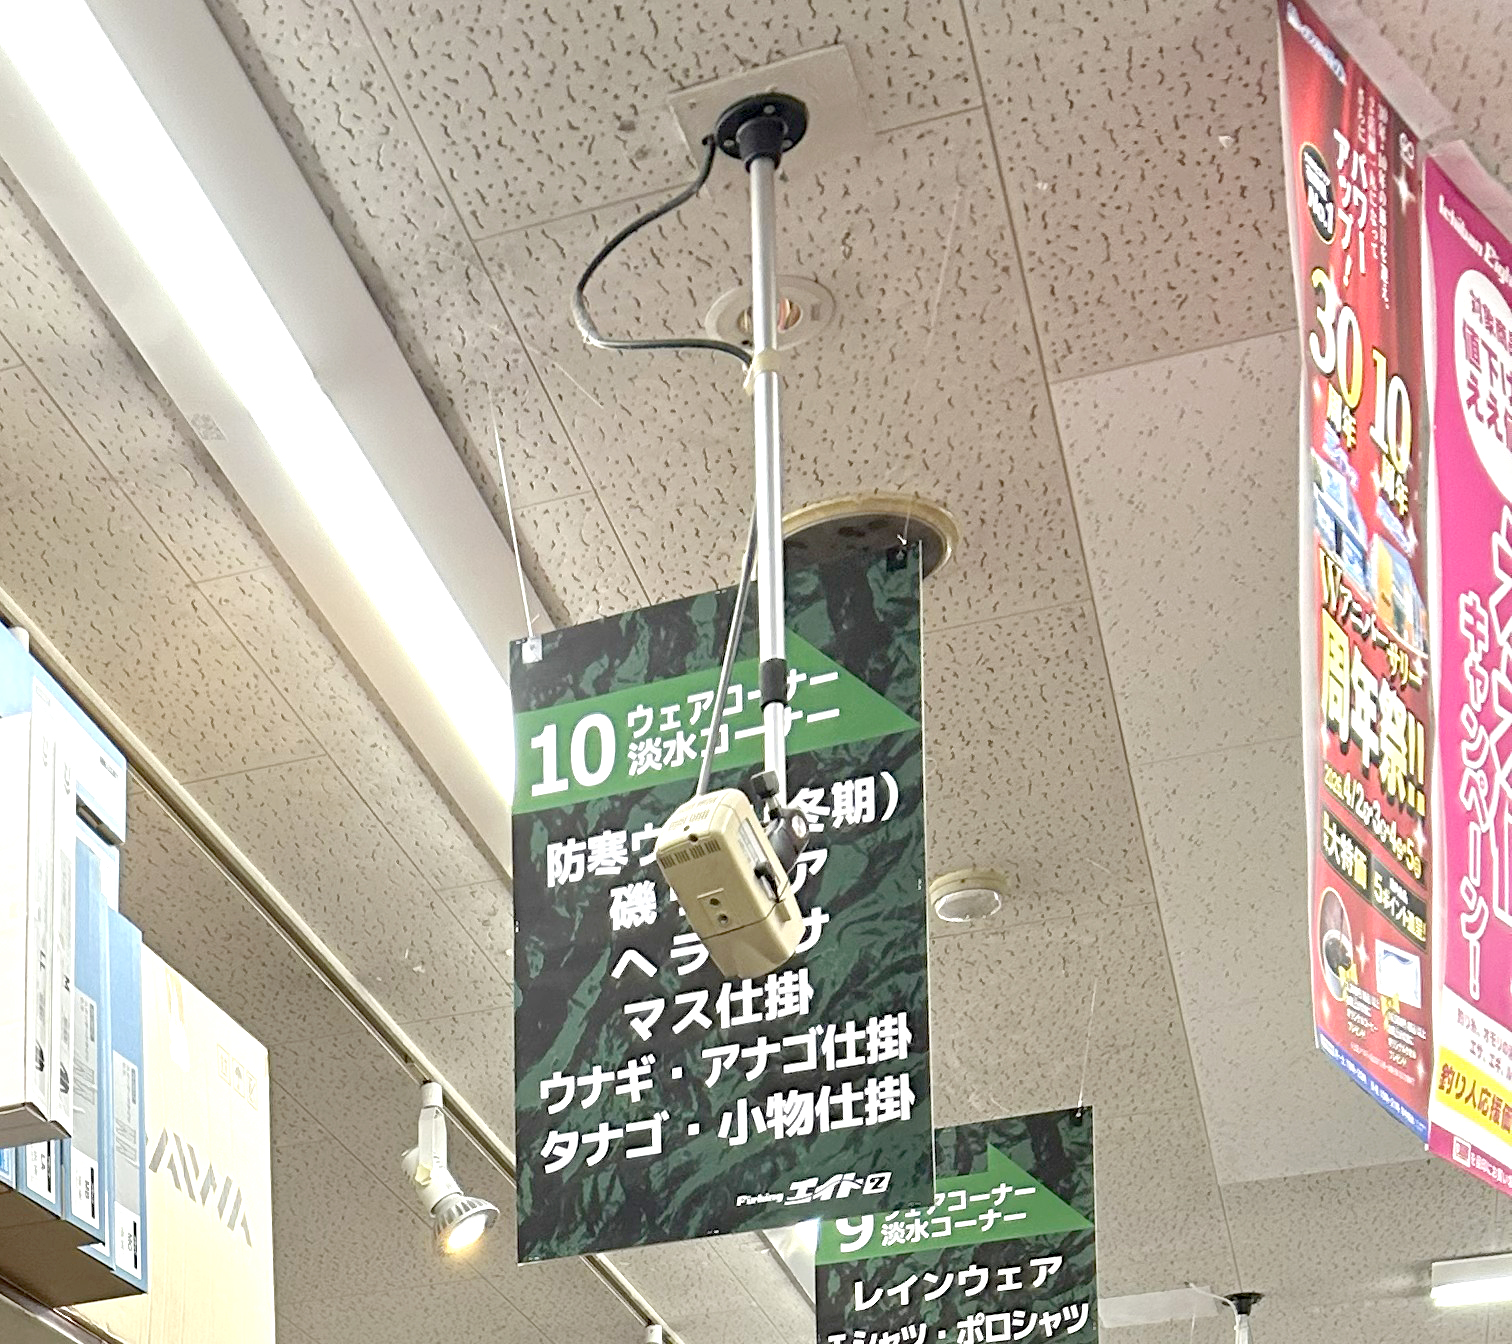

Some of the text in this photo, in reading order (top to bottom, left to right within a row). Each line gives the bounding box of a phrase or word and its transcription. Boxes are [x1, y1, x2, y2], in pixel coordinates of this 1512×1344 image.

[1308, 266, 1364, 410] 30
[1369, 345, 1413, 476] 10
[529, 711, 617, 798] 10
[623, 969, 815, 1042] マス仕掛
[538, 1011, 914, 1116] ウナギ・アナゴ仕掛
[540, 1074, 915, 1175] タナゴ・小物仕掛
[880, 1211, 1028, 1248] 淡水コーナー
[854, 1255, 1063, 1312] レインウェア
